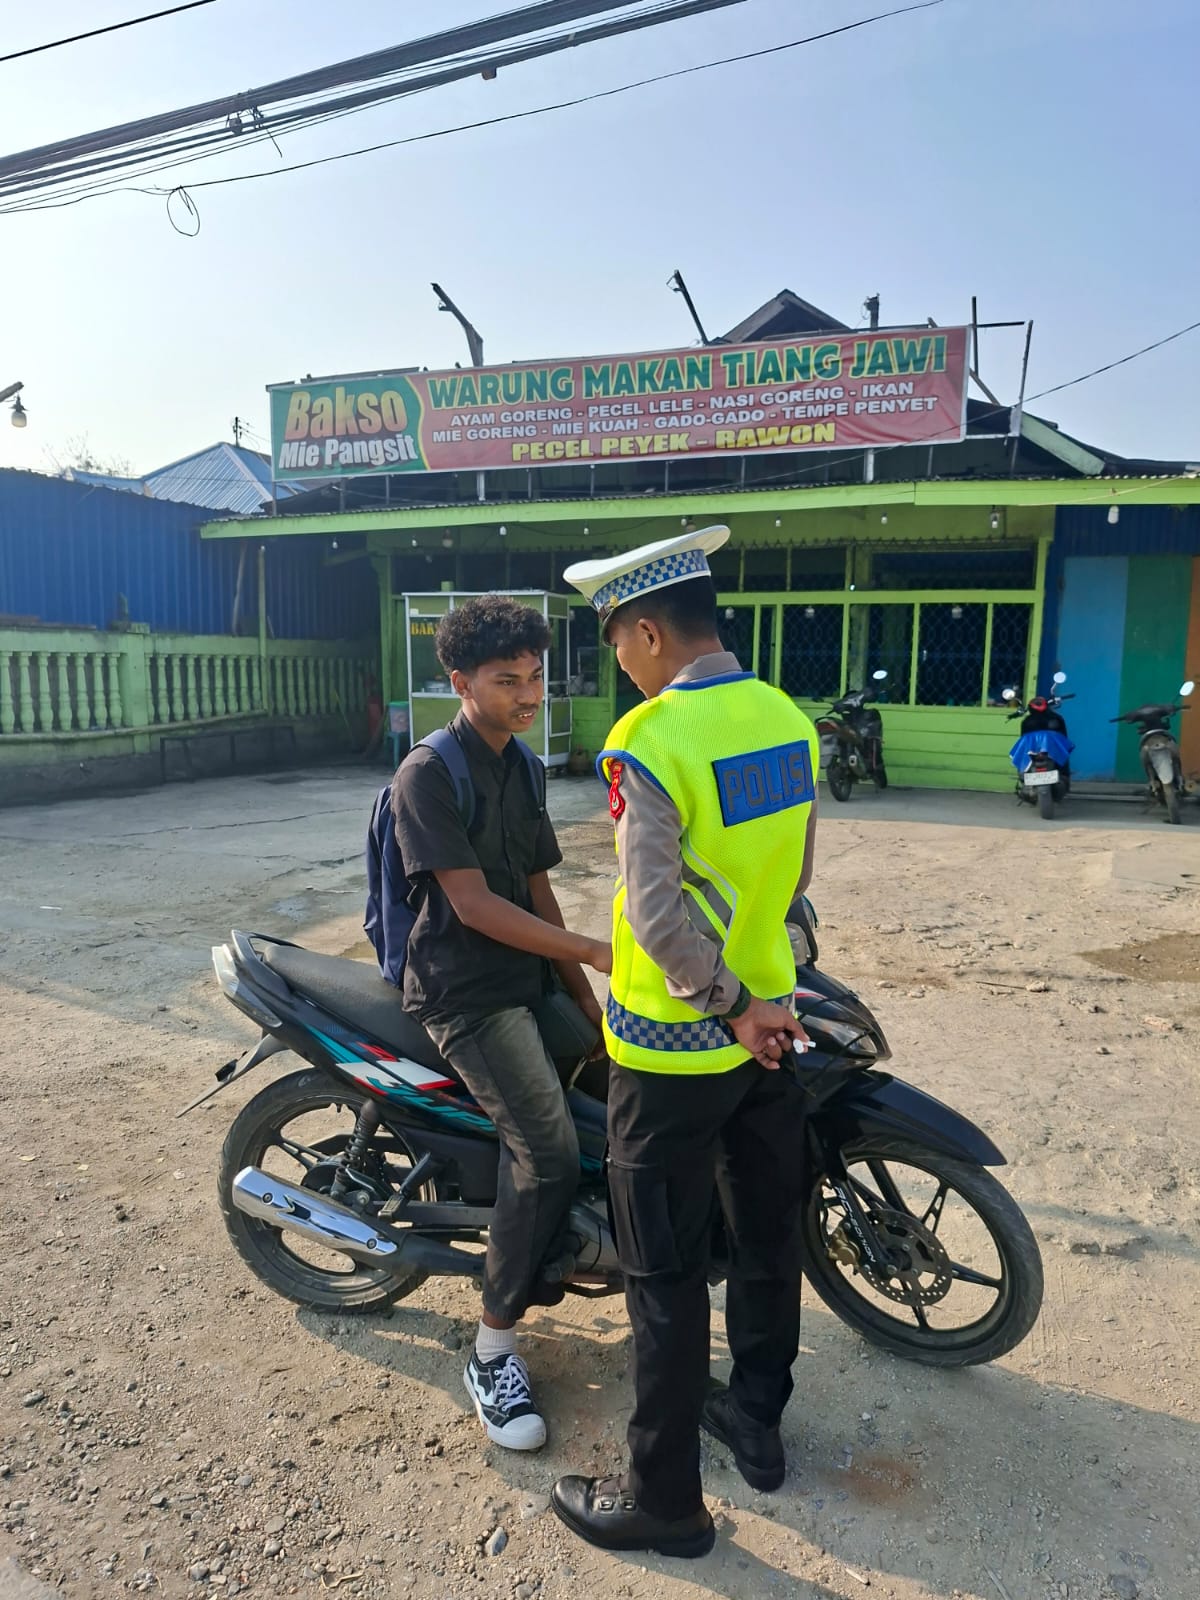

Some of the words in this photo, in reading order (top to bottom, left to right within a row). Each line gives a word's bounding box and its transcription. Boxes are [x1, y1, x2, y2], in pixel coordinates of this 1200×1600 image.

[427, 367, 575, 410] WARUNG
[582, 354, 713, 399] MAKAN
[720, 343, 842, 389] TIANG
[850, 335, 948, 379] JAWI
[284, 386, 408, 441] Bakso
[432, 430, 462, 442] MIE
[466, 425, 537, 441] GORENG
[552, 422, 584, 435] MIE
[588, 418, 639, 433] KUAH
[654, 410, 765, 429] GADO-GADO
[782, 402, 849, 420] TEMPE
[854, 396, 938, 415] PENYET
[450, 412, 495, 427] AYAM
[500, 407, 573, 424] GORENG
[588, 403, 644, 418] PECEL
[649, 398, 694, 414] LELE
[709, 394, 754, 409] NASI
[759, 386, 844, 406] GORENG
[862, 382, 914, 398] IKAN
[278, 441, 319, 469] Mie
[324, 433, 419, 467] Pangsit
[511, 439, 595, 462] PECEL
[601, 432, 690, 457] PEYEK
[715, 422, 836, 449] RAWON
[411, 622, 436, 636] BAK
[723, 751, 813, 816] POLISI
